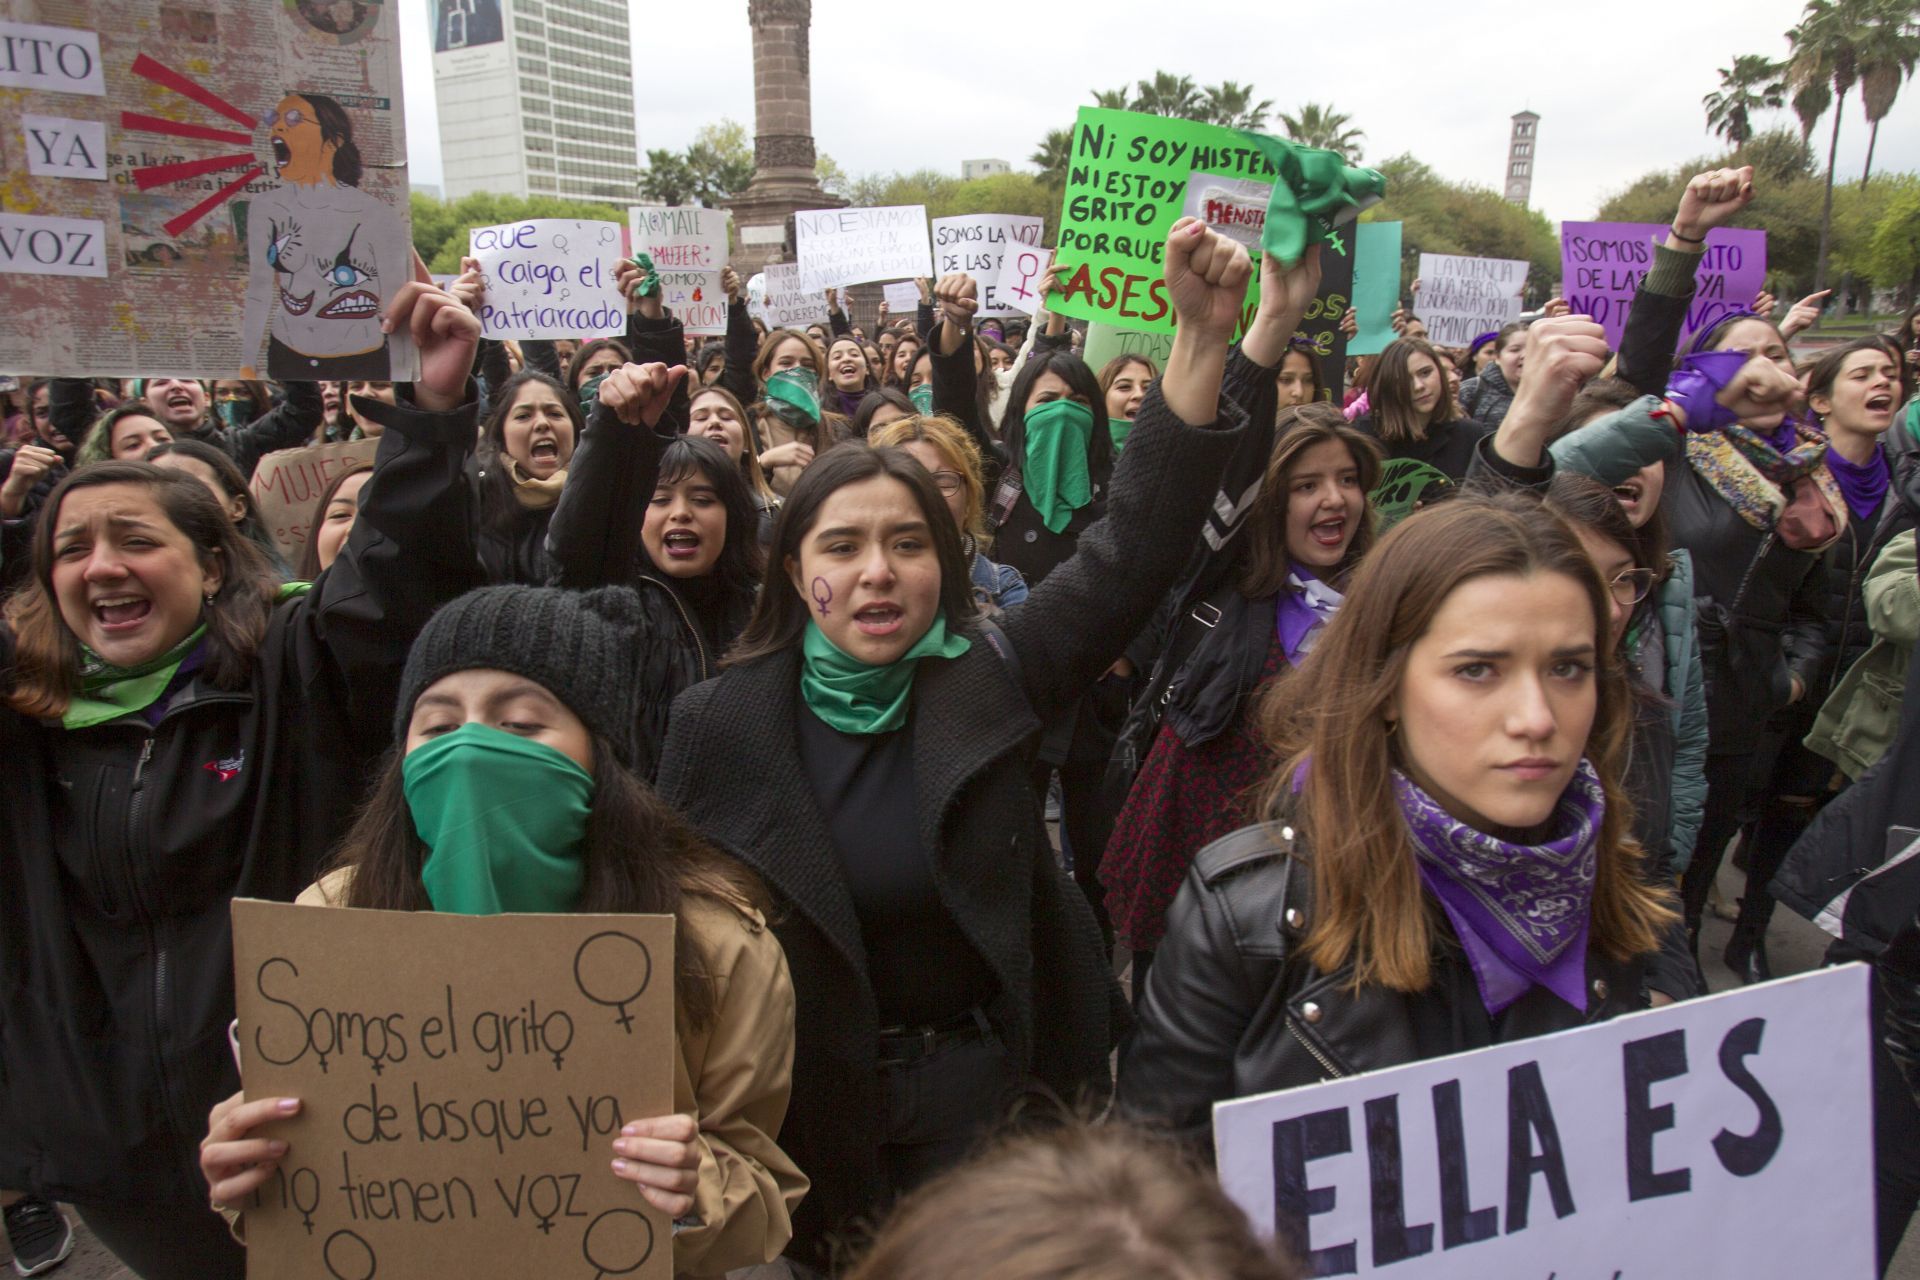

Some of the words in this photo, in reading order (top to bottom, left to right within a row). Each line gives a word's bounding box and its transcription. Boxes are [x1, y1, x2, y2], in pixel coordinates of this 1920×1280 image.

[0, 35, 92, 80] ITO
[29, 128, 98, 170] YA
[1127, 136, 1188, 167] SOY
[1190, 145, 1281, 177] HISTER
[1070, 165, 1100, 189] NI
[1104, 171, 1187, 204] ESTOY
[1068, 195, 1157, 226] GRITO
[0, 227, 95, 268] VOZ
[937, 225, 983, 246] SOMOS
[988, 226, 1007, 244] LA
[1060, 228, 1167, 265] PORQUE
[578, 257, 603, 289] el
[943, 254, 959, 273] DE
[966, 253, 992, 271] LAS
[1702, 245, 1742, 271] ITO
[660, 272, 707, 287] OMOS
[670, 291, 686, 304] LA
[1577, 267, 1605, 290] DE
[1698, 274, 1724, 300] YA
[674, 301, 727, 328] UCIÓN!
[1570, 295, 1610, 325] NO
[1687, 301, 1745, 335] VO
[256, 957, 408, 1076] Somos
[420, 984, 459, 1060] el
[472, 1000, 575, 1072] grito
[343, 1082, 402, 1144] de
[413, 1081, 470, 1142] las
[471, 1097, 553, 1154] que
[567, 1095, 625, 1151] ya
[1273, 1060, 1577, 1277] ELLA
[1623, 1016, 1784, 1203] ES
[340, 1151, 478, 1223] tienen
[495, 1174, 589, 1235] voz
